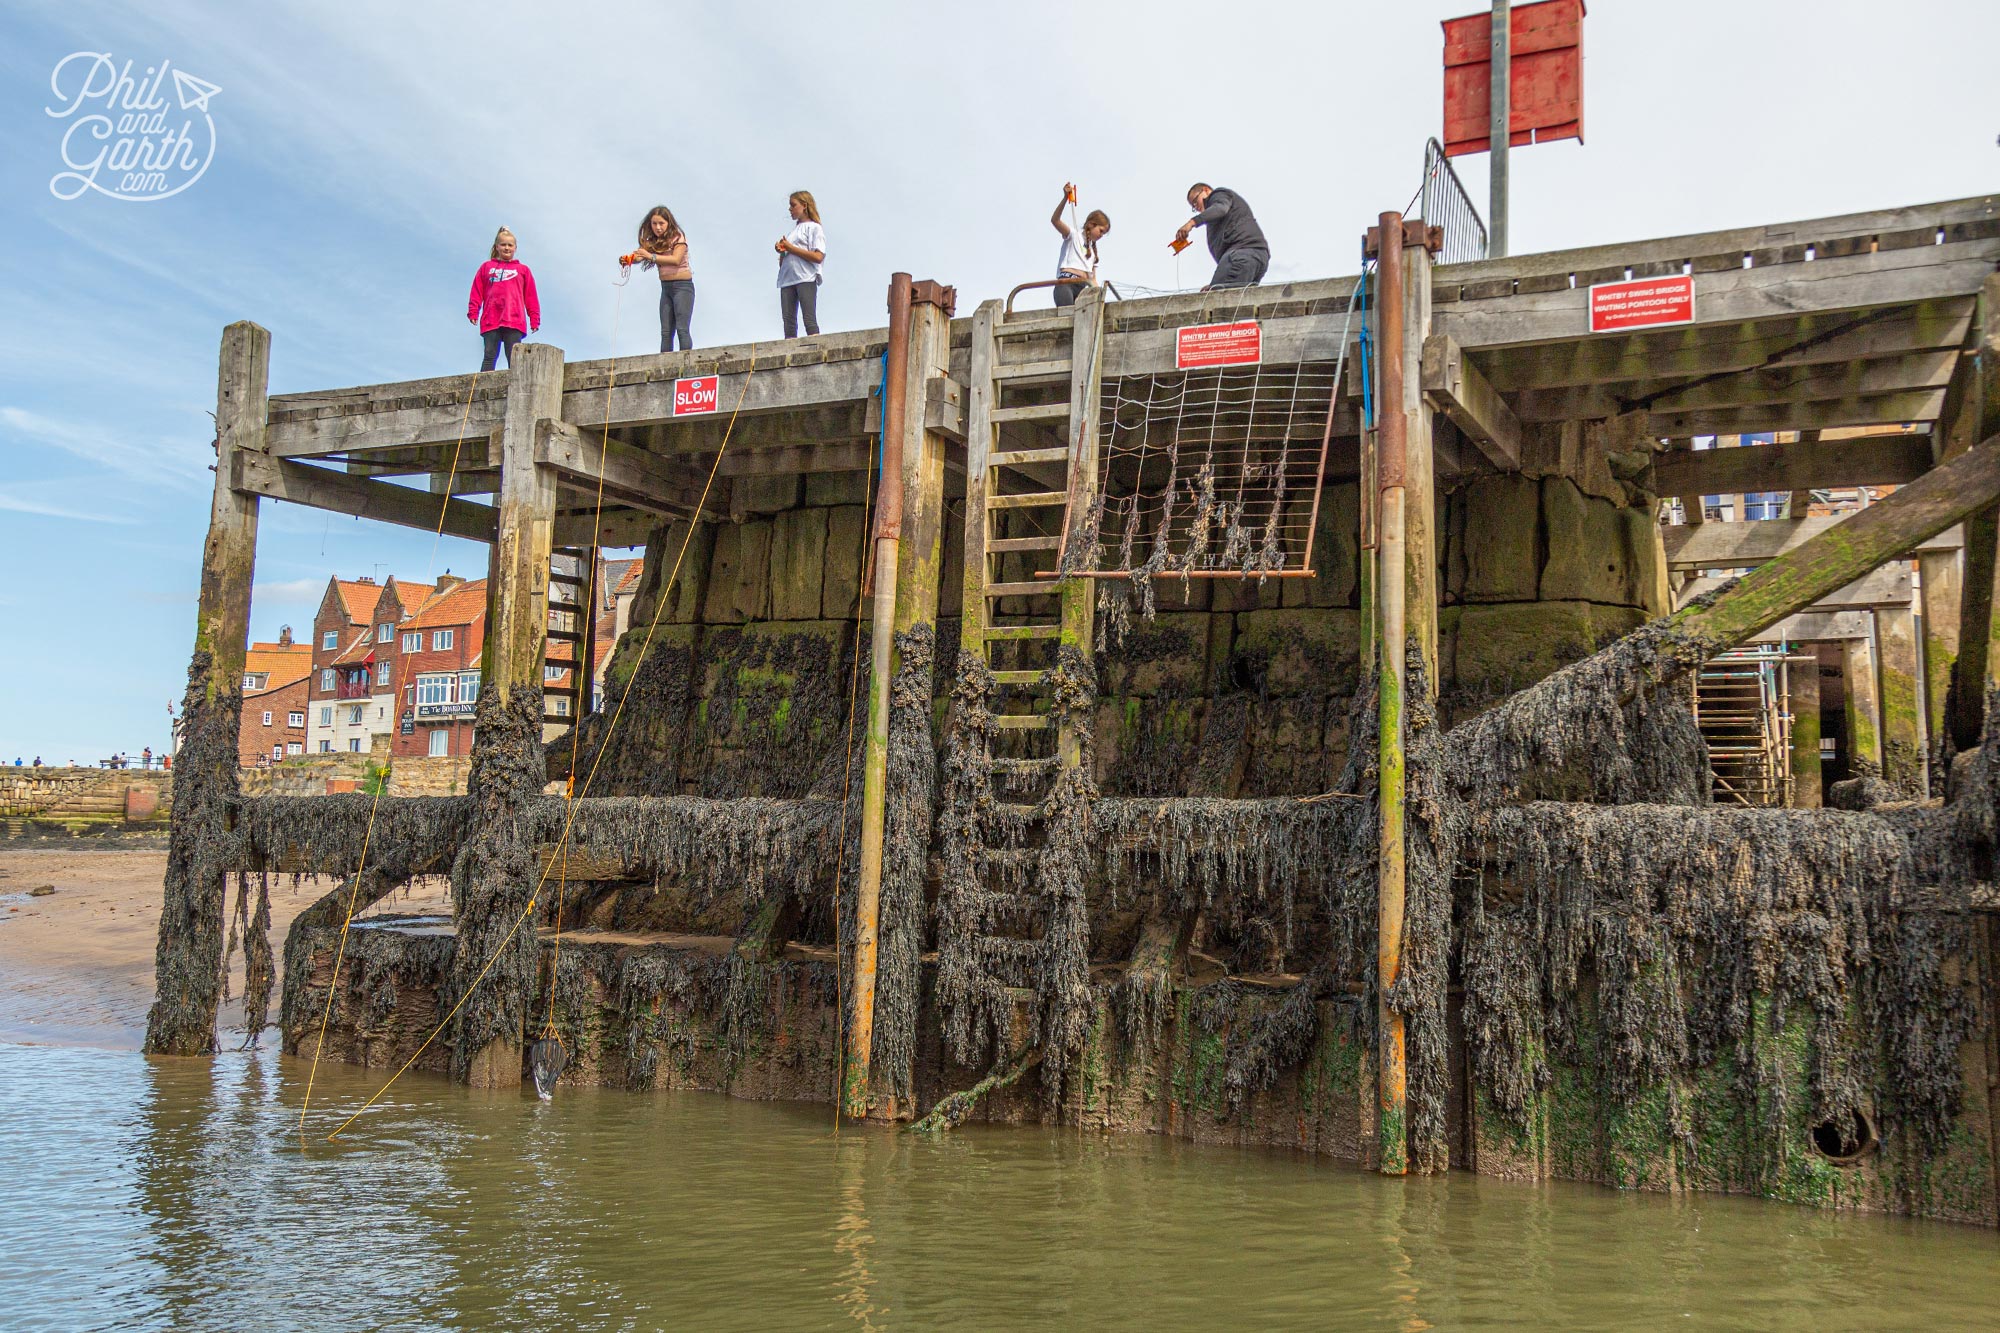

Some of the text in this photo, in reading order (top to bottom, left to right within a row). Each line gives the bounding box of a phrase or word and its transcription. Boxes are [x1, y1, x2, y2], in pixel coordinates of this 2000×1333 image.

[1596, 284, 1687, 302] WHITBY SWING BRIDGE
[1594, 295, 1690, 313] WAITING PONTOON ONLY
[1181, 332, 1207, 341] WHITBY
[1208, 330, 1230, 339] SWING
[1231, 327, 1257, 336] BRIDGE
[677, 390, 715, 406] SLOW
[430, 705, 441, 713] The
[441, 705, 460, 713] BOARD
[460, 704, 472, 712] INN
